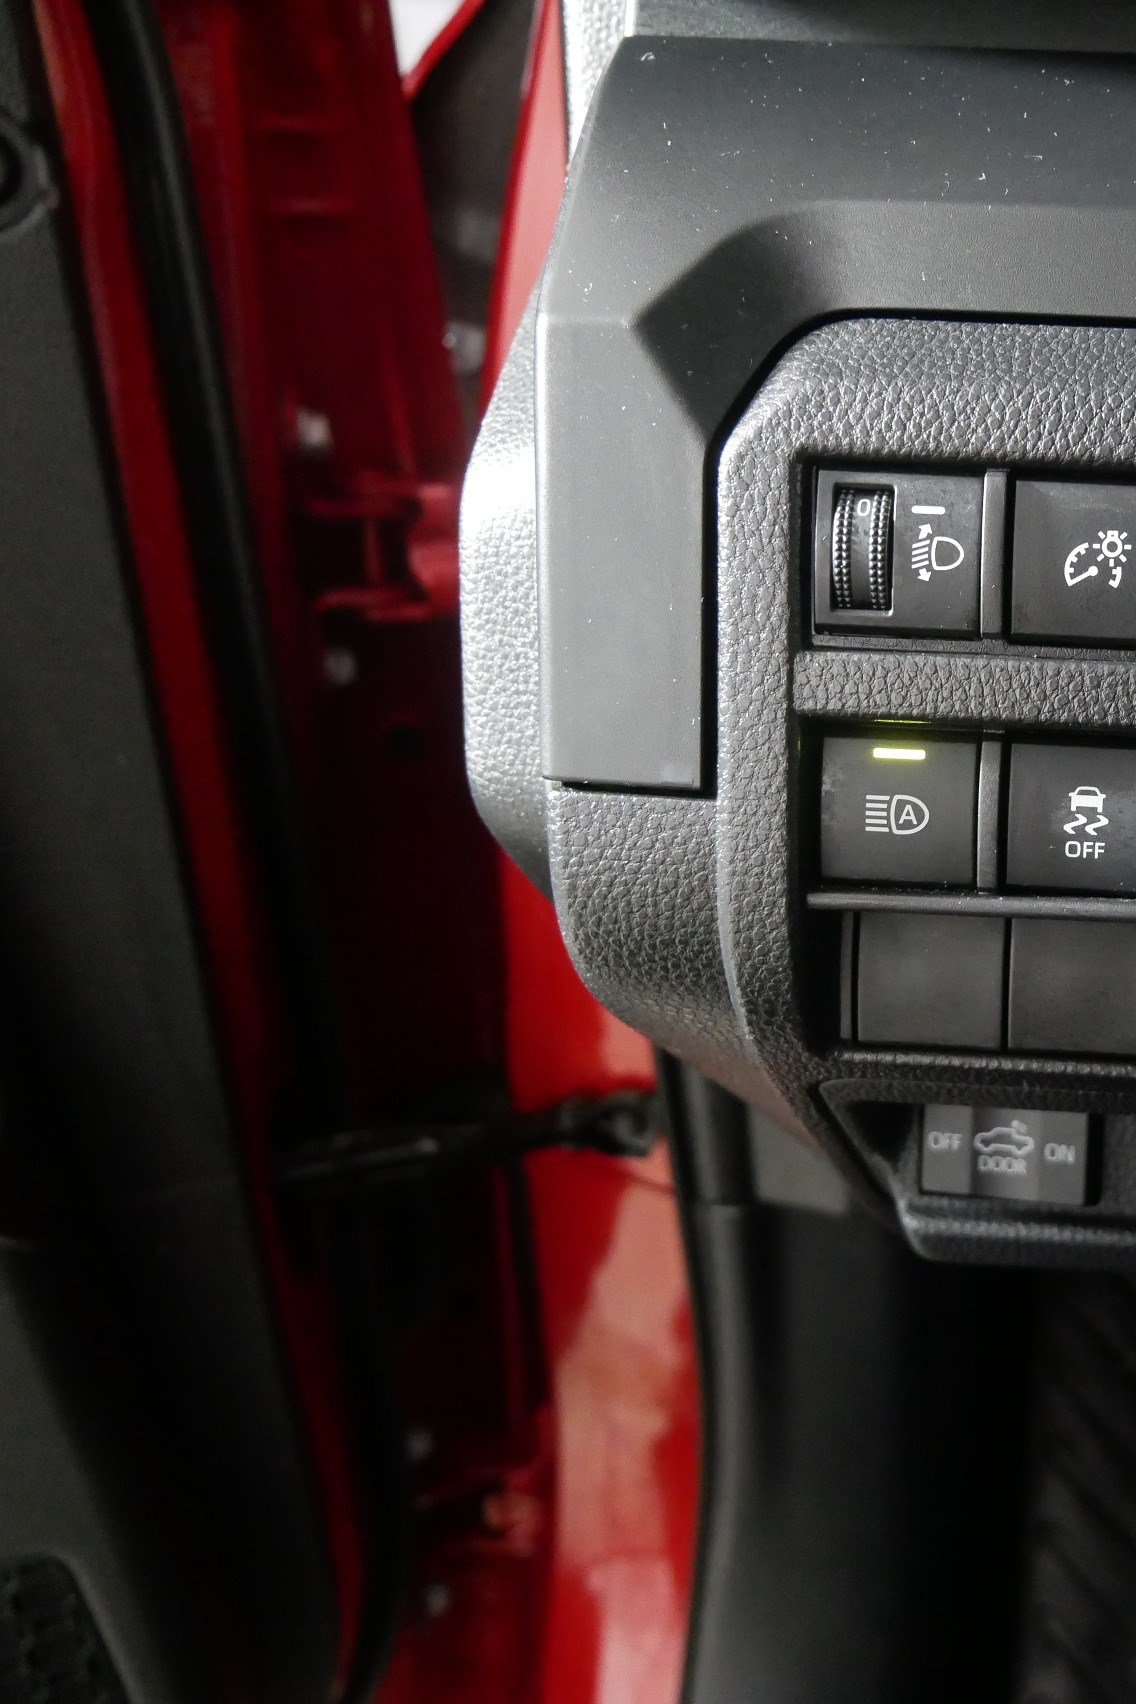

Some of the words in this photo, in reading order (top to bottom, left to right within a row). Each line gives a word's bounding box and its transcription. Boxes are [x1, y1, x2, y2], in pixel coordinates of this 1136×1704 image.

[898, 804, 918, 825] A
[1064, 840, 1106, 859] OFF
[928, 1131, 962, 1152] OFF
[977, 1154, 1028, 1174] DOOR
[1044, 1143, 1076, 1164] ON
